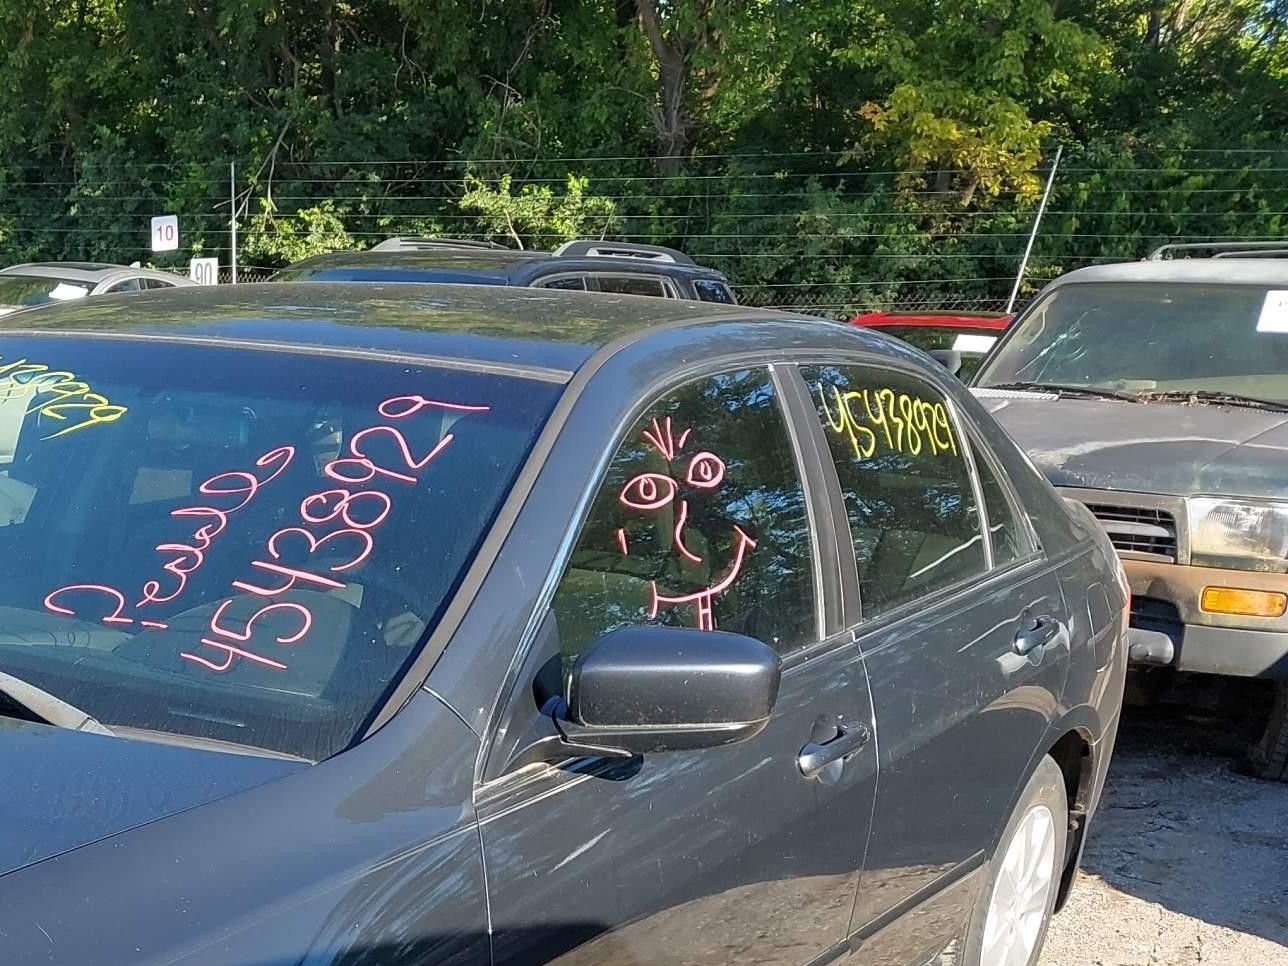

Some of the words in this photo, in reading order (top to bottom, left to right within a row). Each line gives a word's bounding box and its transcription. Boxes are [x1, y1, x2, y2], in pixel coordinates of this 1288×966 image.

[156, 224, 174, 242] 10
[816, 381, 958, 460] 45438929
[180, 394, 491, 673] 45438929
